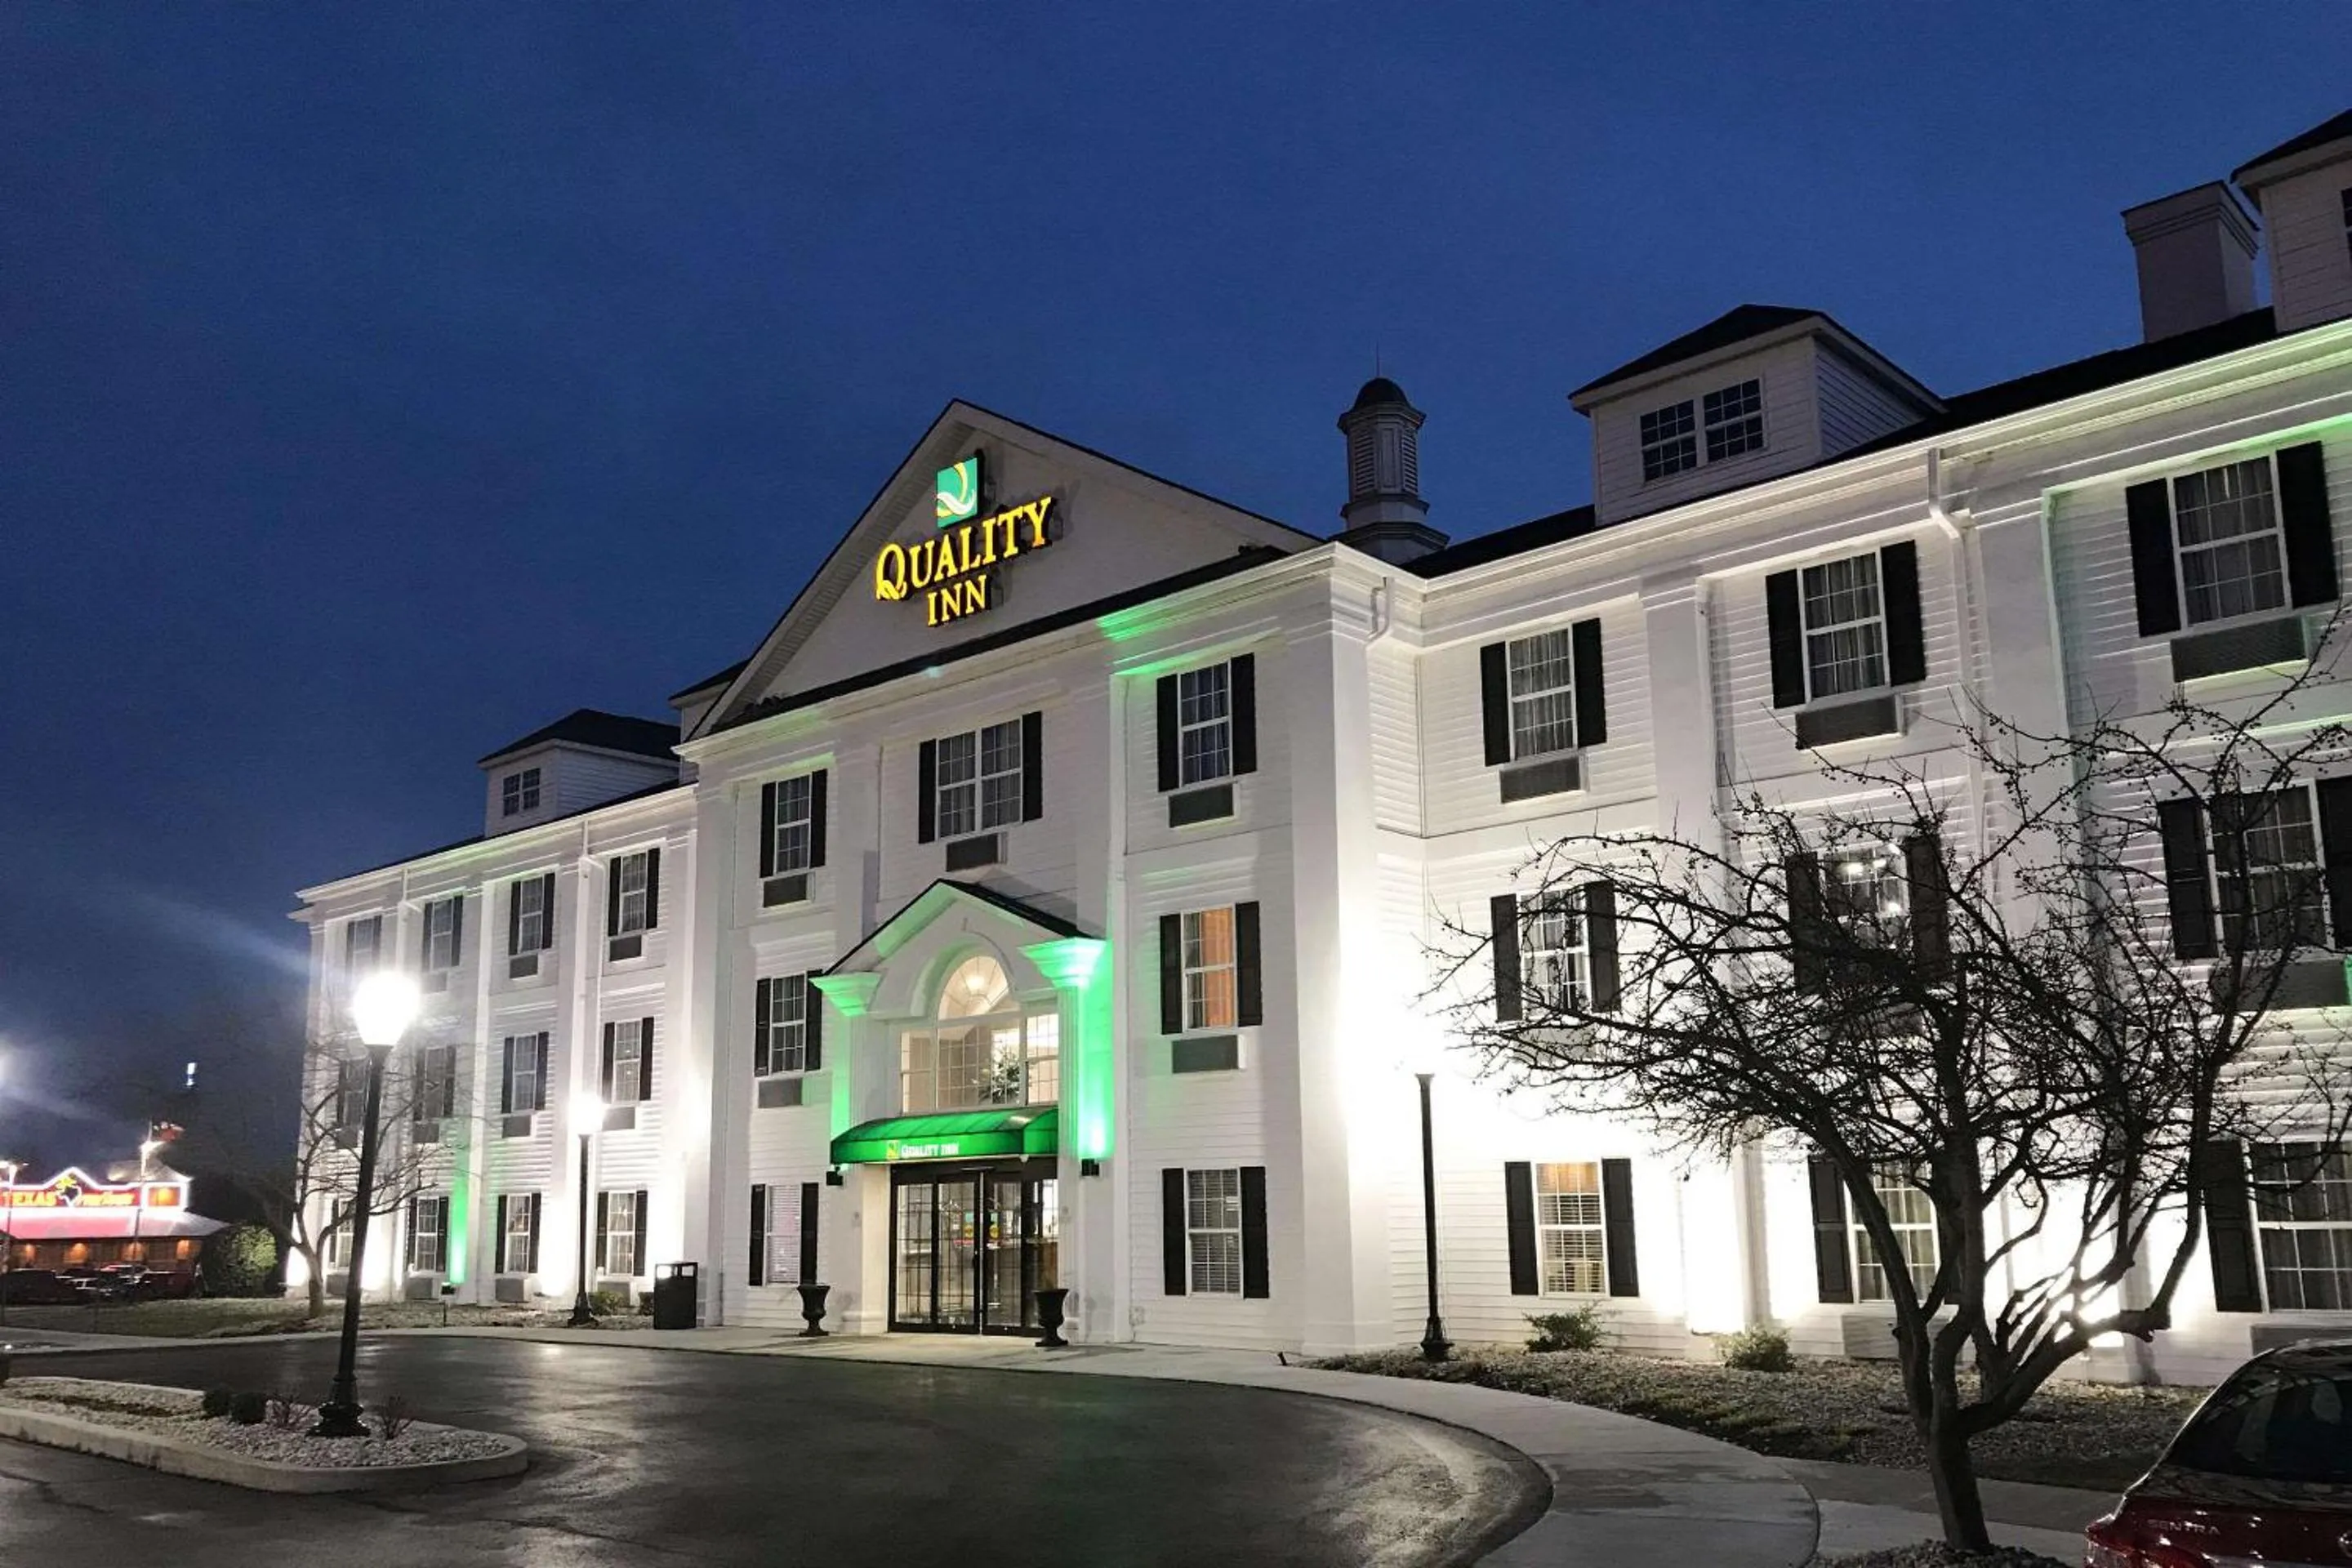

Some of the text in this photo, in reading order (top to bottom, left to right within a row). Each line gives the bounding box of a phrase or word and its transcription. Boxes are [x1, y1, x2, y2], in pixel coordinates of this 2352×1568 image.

[875, 496, 1053, 600] QUALITY
[927, 574, 987, 626] INN
[901, 1144, 939, 1159] QUALITY
[2, 1190, 57, 1206] TEXAS
[2146, 1519, 2221, 1535] SENTRA
